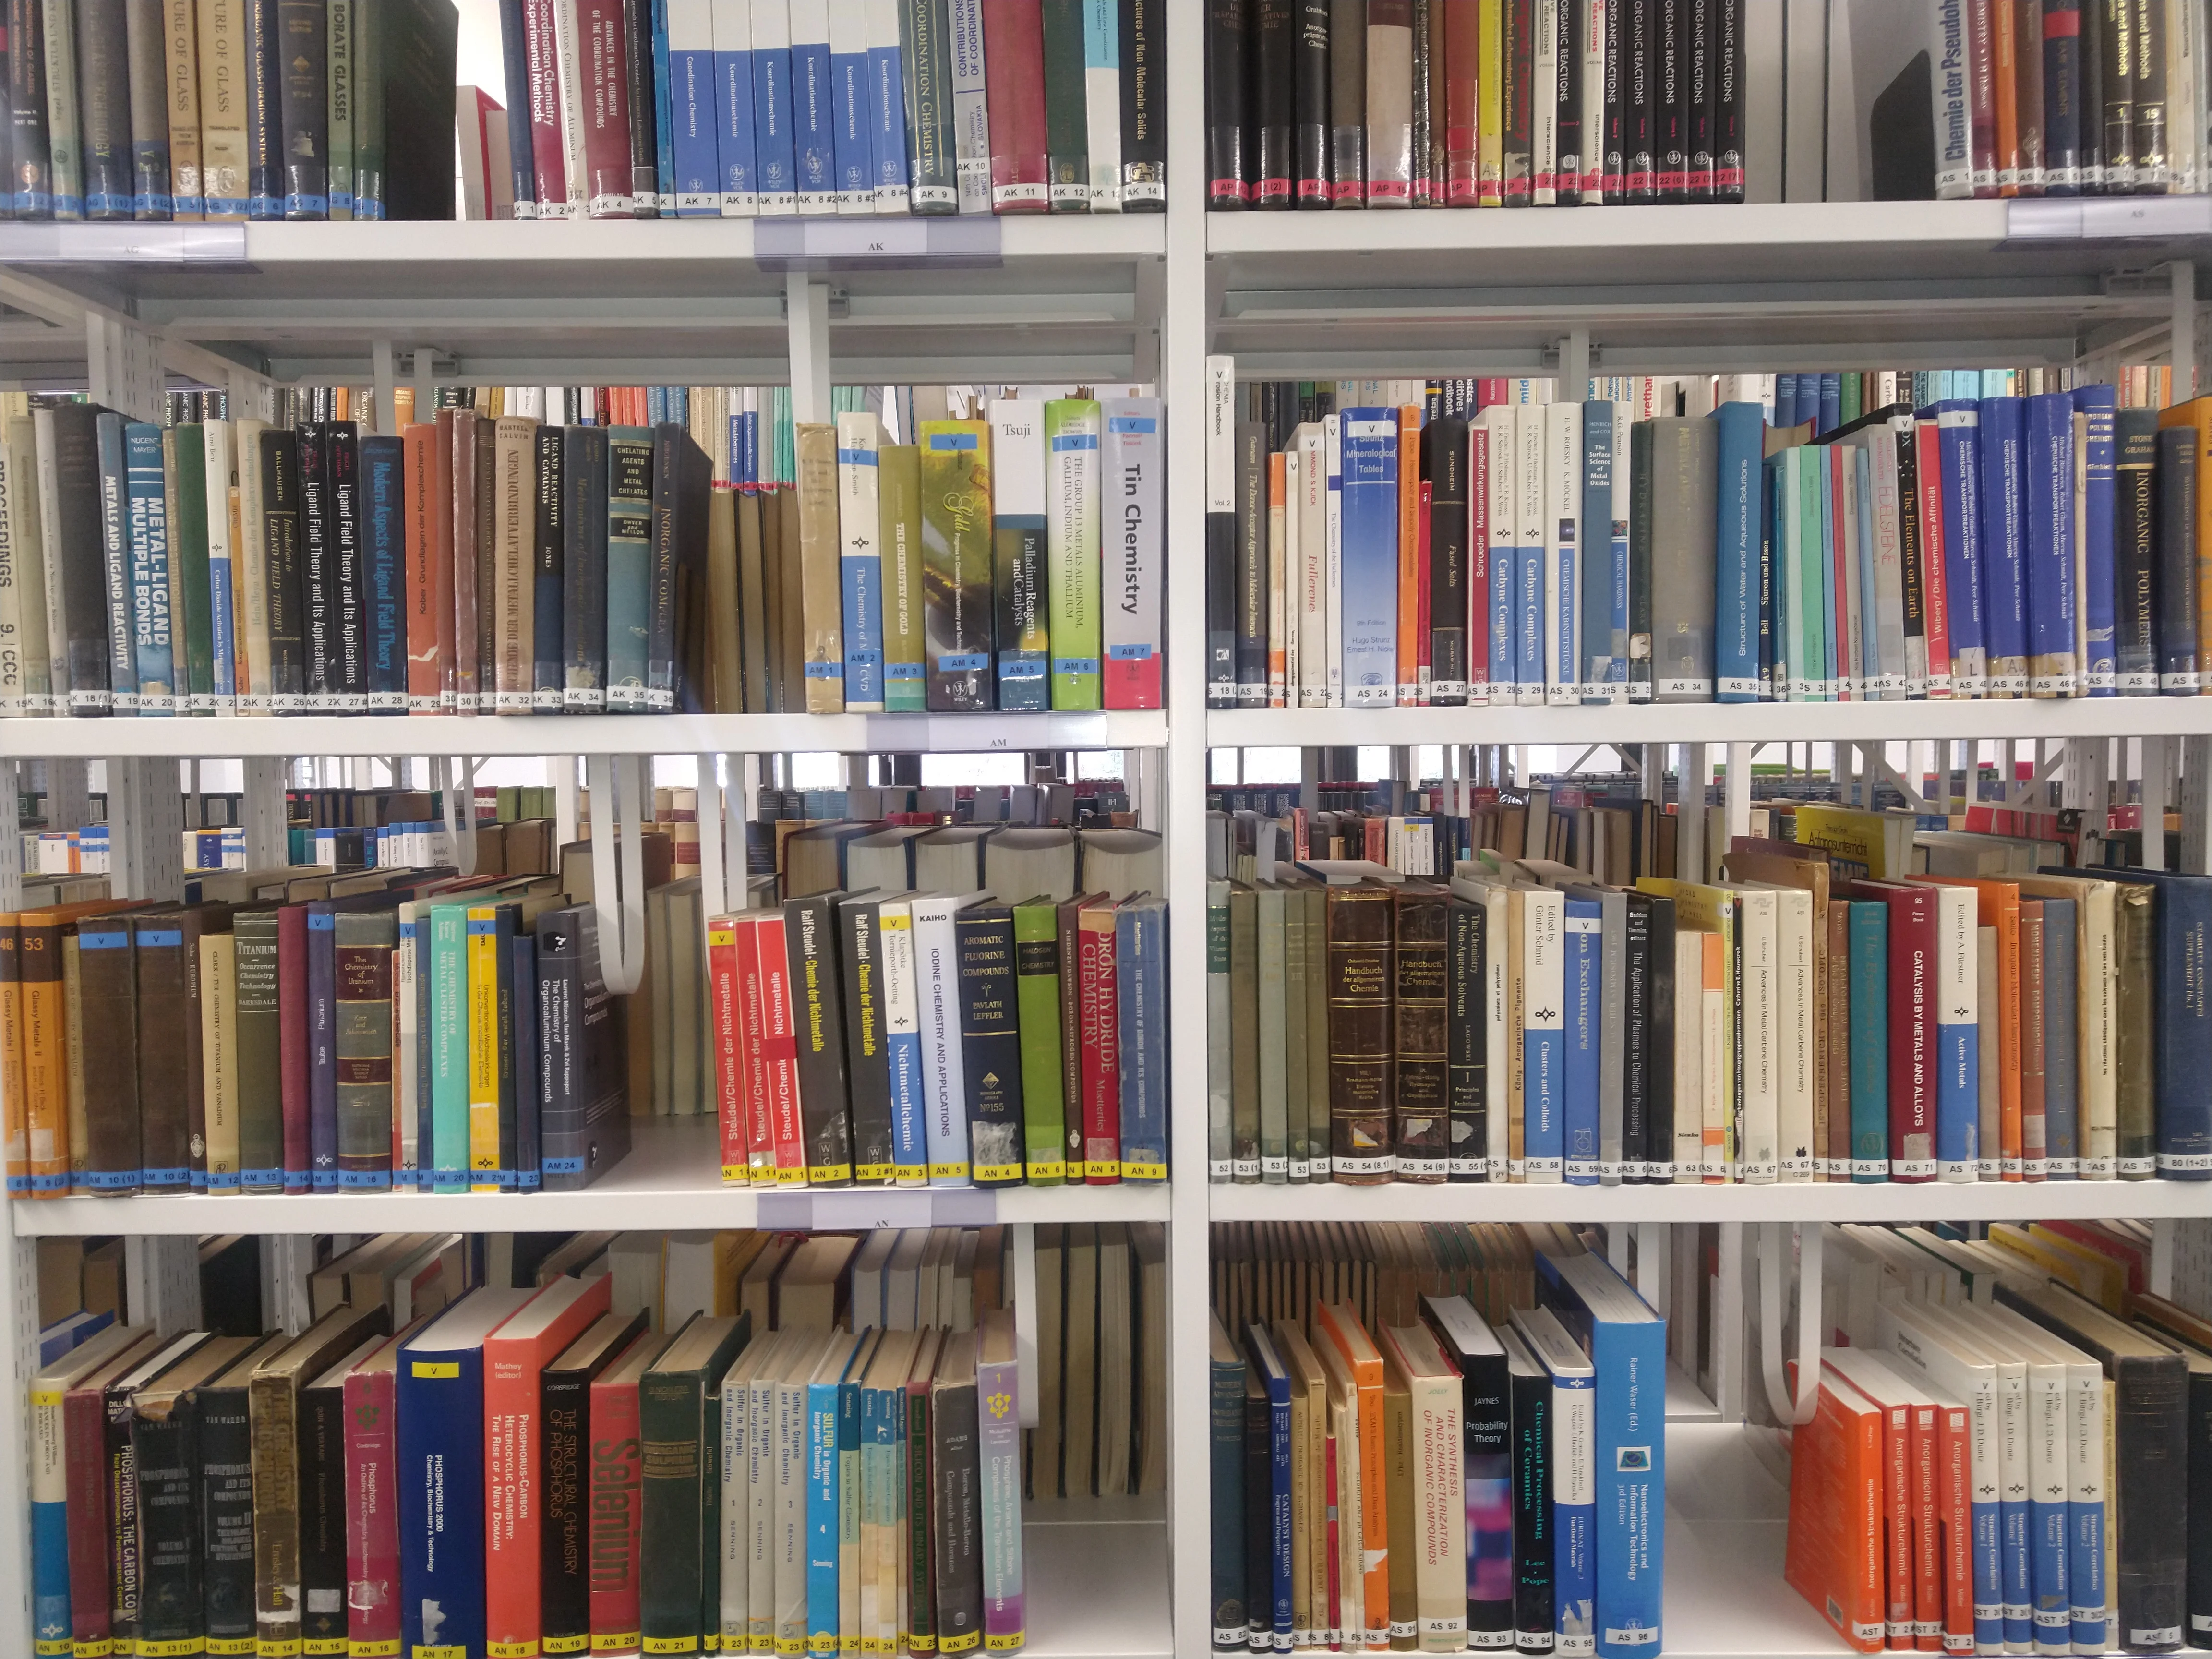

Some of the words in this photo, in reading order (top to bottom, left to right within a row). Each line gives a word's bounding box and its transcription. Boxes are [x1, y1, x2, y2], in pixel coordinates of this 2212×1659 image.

[333, 4, 344, 60] BORATE
[592, 10, 600, 20] OF
[606, 20, 614, 52] ADVANCES
[594, 37, 602, 84] COORDINATION
[1608, 49, 1616, 103] REACTIONS
[1723, 47, 1732, 102] REACTIONS
[333, 64, 346, 122] GLASSES
[608, 83, 618, 116] CHEMISTRY
[730, 64, 738, 138] Koordinationschemie
[808, 57, 816, 131] Koordinationschemie
[1942, 74, 1963, 99] der
[596, 86, 604, 128] COMPOUNDS
[922, 102, 934, 176] CHEMISTRY
[1946, 103, 1964, 160] Chemie
[1003, 424, 1031, 437] Tsuji
[617, 447, 649, 456] CHELATING
[1346, 449, 1395, 460] Mineralogical
[1359, 464, 1384, 473] Tables
[1124, 463, 1140, 496] Tin
[1477, 432, 1485, 528] Massenwirkungsgesetz
[1740, 459, 1748, 503] Solutions
[1904, 488, 1914, 510] The
[105, 476, 118, 523] METALS
[338, 483, 349, 518] Ligand
[2136, 471, 2150, 553] INORGANIC
[108, 525, 120, 551] AND
[131, 498, 149, 582] MULTIPLE
[340, 520, 351, 544] Field
[1075, 517, 1082, 526] 13
[1740, 505, 1748, 547] Aqueous
[1905, 515, 1915, 565] Elements
[108, 552, 121, 599] LIGAND
[147, 498, 168, 646] METAL-LIGAND
[341, 547, 352, 582] Theory
[1121, 504, 1142, 615] Chemistry
[1908, 569, 1915, 583] on
[343, 586, 352, 603] and
[1496, 559, 1508, 602] Carbyne
[134, 584, 151, 647] BONDS
[344, 605, 355, 620] Its
[1739, 601, 1746, 610] of
[1908, 587, 1919, 618] Earth
[2136, 570, 2151, 647] POLYMERS
[112, 602, 129, 670] REACTIVITY
[1496, 605, 1508, 661] Complexes
[1739, 613, 1747, 657] Structure
[344, 624, 356, 685] Applications
[25, 938, 44, 950] 53
[237, 942, 276, 955] TITANIUM
[964, 936, 1004, 944] AROMATIC
[965, 950, 1005, 960] FLUORINE
[931, 948, 940, 981] IODINE
[963, 967, 1009, 976] COMPOUNDS
[1913, 950, 1923, 1004] CATALYSIS
[32, 991, 40, 1018] Glassy
[541, 980, 551, 1051] Organoaluminum
[720, 973, 733, 1034] Nichtmetalle
[932, 984, 943, 1040] CHEMISTRY
[1083, 943, 1097, 1049] CHEMISTRY
[1914, 1006, 1923, 1019] BY
[33, 1021, 41, 1047] Metals
[725, 1037, 733, 1054] der
[1100, 986, 1114, 1074] HYDRIDE
[1914, 1022, 1923, 1061] METALS
[1958, 1036, 1966, 1060] Active
[937, 1042, 945, 1063] AND
[543, 1054, 552, 1103] Compounds
[1914, 1063, 1923, 1084] AND
[897, 1043, 912, 1152] Nichtmetallchemie
[938, 1065, 949, 1137] APPLICATIONS
[1914, 1087, 1923, 1126] ALLOYS
[1905, 1164, 1917, 1172] AS
[495, 1363, 521, 1371] Mathey
[1630, 1358, 1638, 1382] Rainer
[1474, 1397, 1499, 1405] JAYNES
[1630, 1385, 1638, 1409] Waser
[493, 1415, 502, 1433] THE
[823, 1413, 833, 1447] SULFUR
[1424, 1410, 1432, 1425] OF
[1436, 1416, 1444, 1440] AND
[1447, 1408, 1455, 1430] THE
[1467, 1421, 1508, 1431] Probability
[1524, 1429, 1532, 1444] of
[1536, 1401, 1544, 1463] Chemical
[1628, 1412, 1638, 1431] (Ed.)
[493, 1436, 502, 1457] RISE
[505, 1415, 515, 1482] HETEROCYCLIC
[1425, 1427, 1434, 1489] INORGANIC
[1474, 1434, 1501, 1443] Theory
[121, 1445, 135, 1521] PHOSPHORUS:
[519, 1414, 529, 1518] PHOSPHORUS-CARBON
[1448, 1433, 1458, 1496] SYNTHESIS
[1524, 1447, 1533, 1510] Ceramics
[1952, 1440, 1961, 1505] Anorganische
[493, 1486, 502, 1508] NEW
[1437, 1443, 1449, 1557] CHARACTERIZATION
[1534, 1468, 1544, 1539] Processing
[1617, 1484, 1626, 1496] 3rd
[1630, 1484, 1638, 1532] Information
[505, 1485, 515, 1539] CHEMISTRY:
[591, 1438, 640, 1592] Selenium
[1426, 1493, 1437, 1565] COMPOUNDS
[1619, 1499, 1627, 1524] Edition
[1640, 1484, 1648, 1551] Nanoelectronics
[123, 1525, 134, 1545] THE
[493, 1512, 502, 1551] DOMAIN
[1954, 1505, 1963, 1581] Strukturchemie
[124, 1548, 135, 1591] CARBON
[1628, 1535, 1638, 1581] Technology
[125, 1594, 137, 1622] COPY
